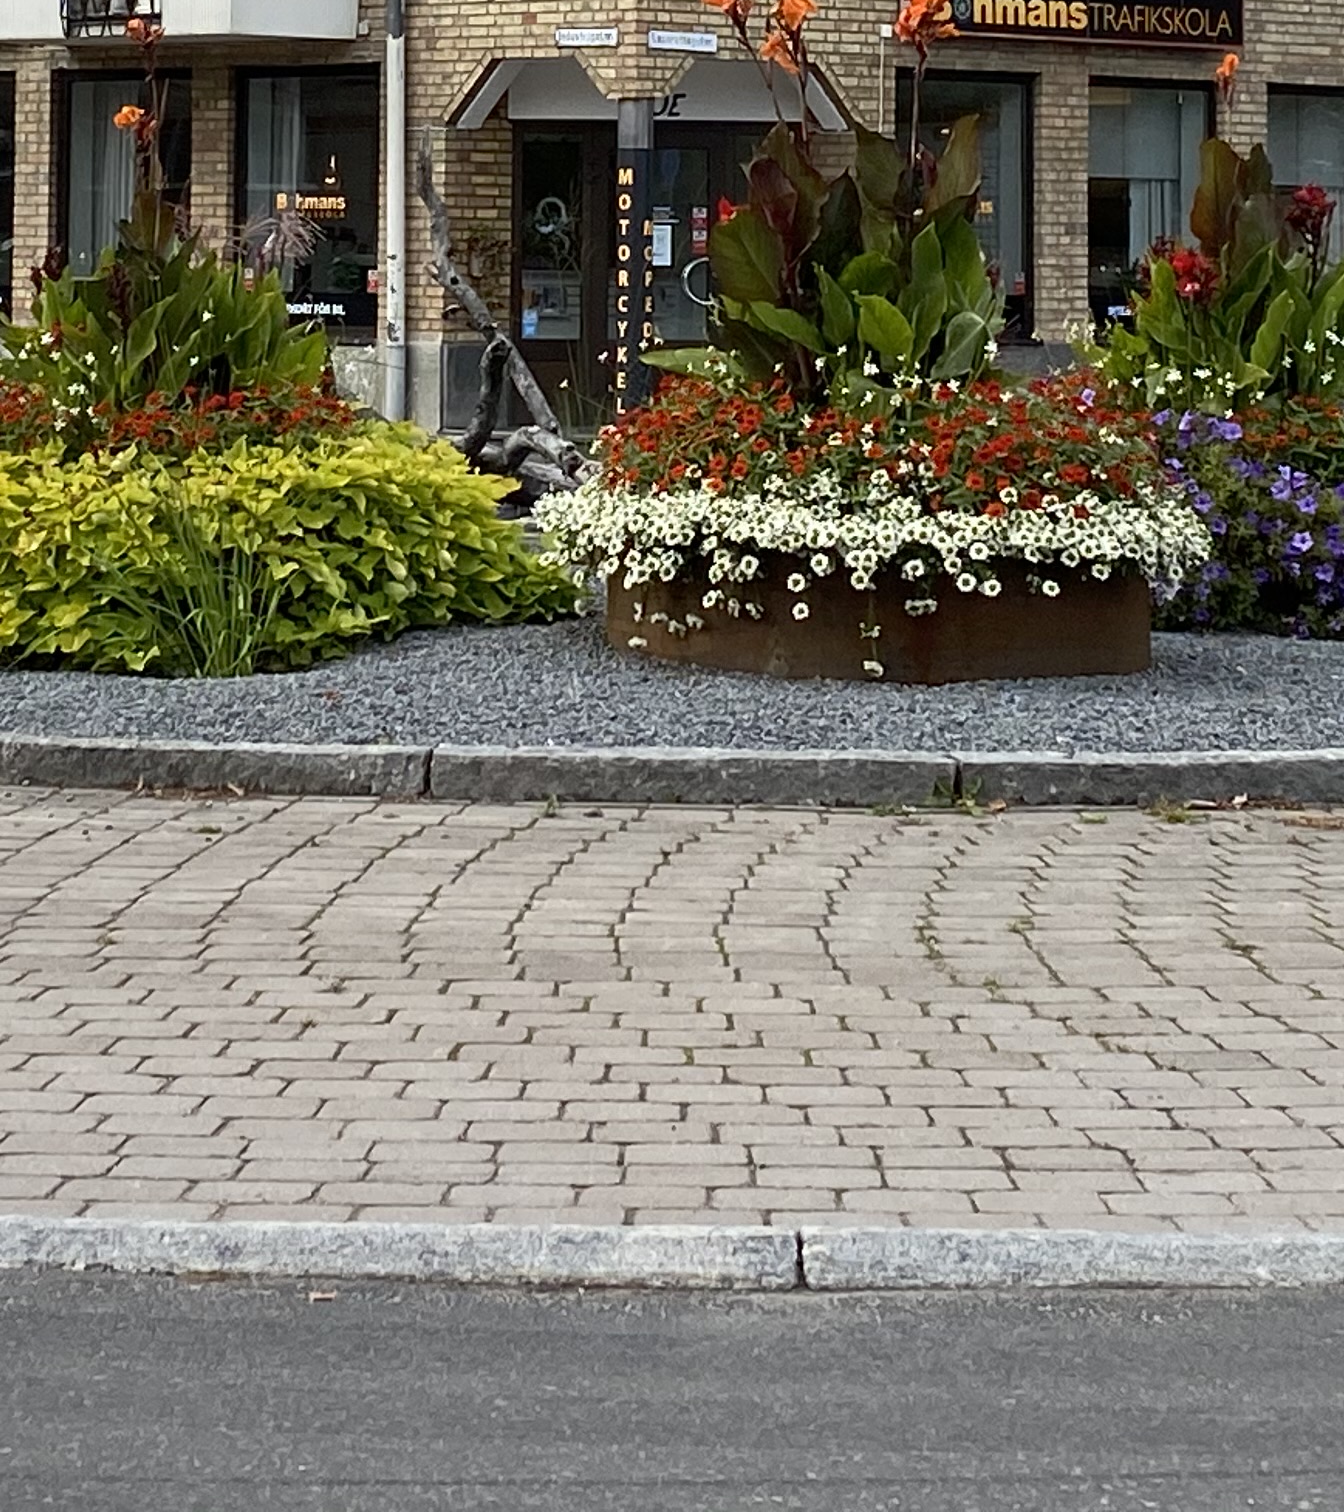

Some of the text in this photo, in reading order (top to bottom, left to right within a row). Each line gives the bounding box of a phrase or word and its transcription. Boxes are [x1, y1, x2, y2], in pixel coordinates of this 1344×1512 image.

[1090, 2, 1233, 38] TRAFIKSKOLA
[276, 192, 346, 210] Bhmans
[616, 167, 634, 416] MOTORCYKEL
